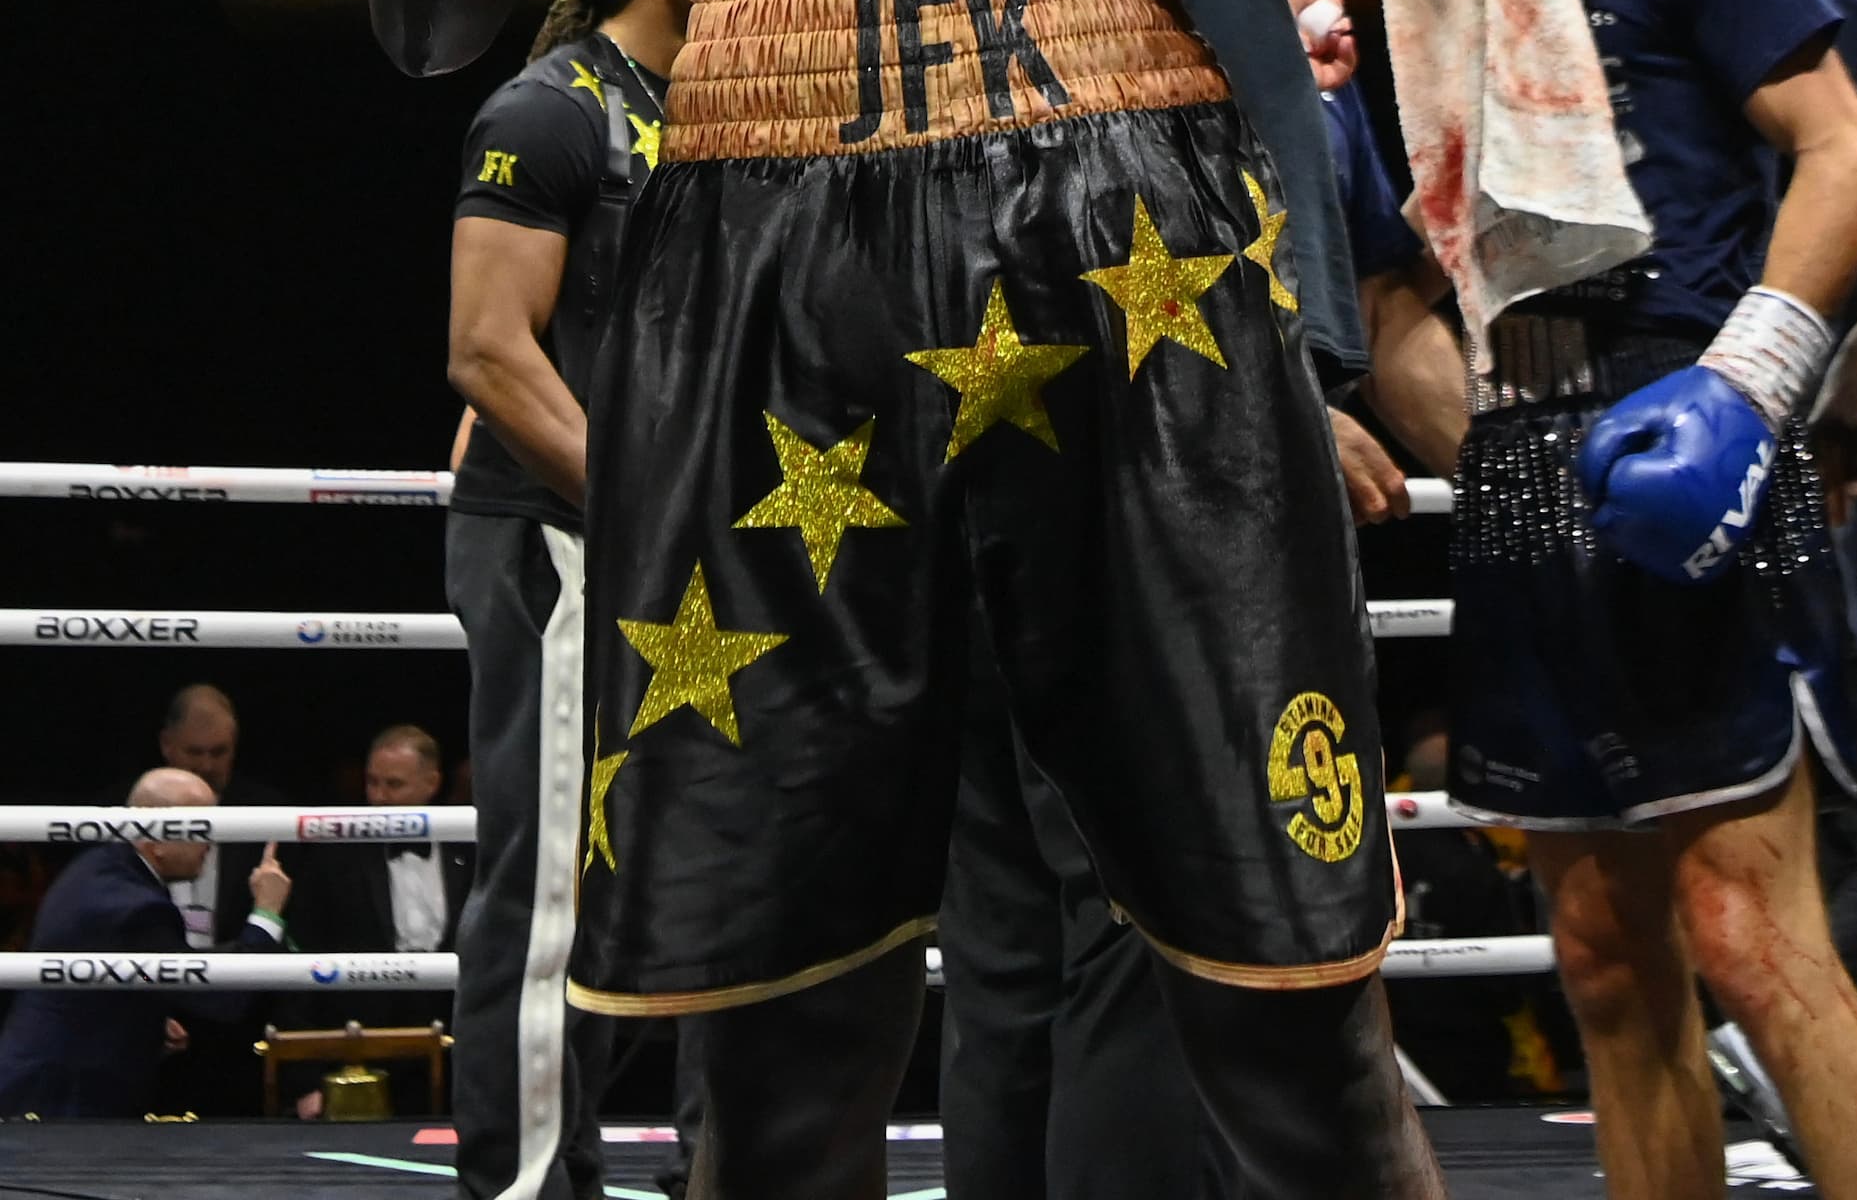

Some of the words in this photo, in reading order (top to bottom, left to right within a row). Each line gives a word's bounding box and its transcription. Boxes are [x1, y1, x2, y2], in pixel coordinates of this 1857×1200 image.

[36, 616, 200, 642] BOXXER
[47, 820, 212, 843] BOXXER
[303, 814, 425, 839] BETFRED
[40, 959, 210, 984] BOXXER
